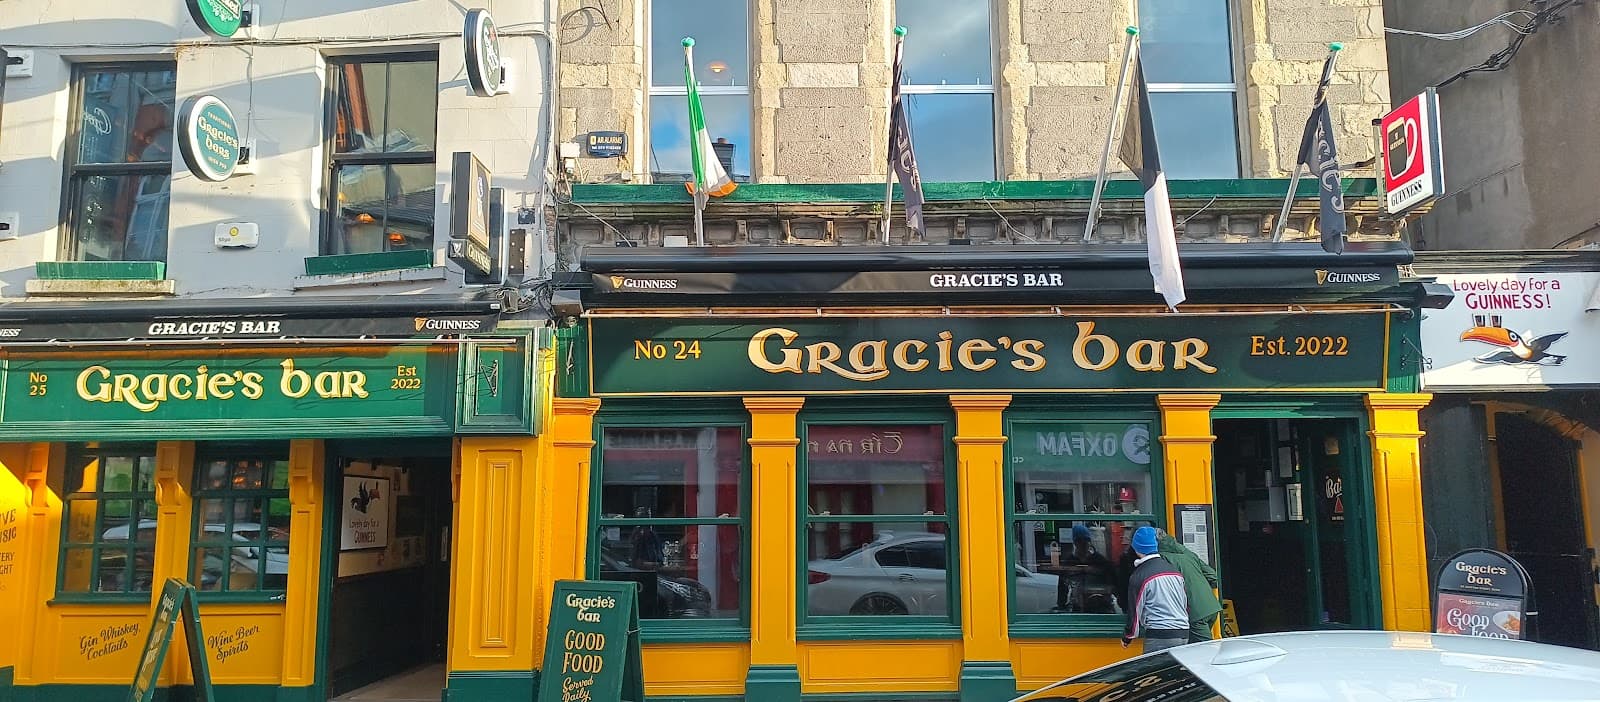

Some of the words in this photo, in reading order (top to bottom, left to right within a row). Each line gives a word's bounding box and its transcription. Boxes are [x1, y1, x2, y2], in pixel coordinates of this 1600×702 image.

[1391, 180, 1422, 206] GUINNESS
[624, 278, 678, 289] GUINNESS
[929, 273, 1018, 288] GRACIE'S
[1023, 273, 1064, 287] BAR
[1327, 272, 1380, 283] GUINNESS
[1453, 279, 1498, 294] Lovely
[1501, 278, 1526, 294] day
[1529, 277, 1548, 290] for
[1552, 280, 1560, 290] a
[148, 321, 237, 335] GRACIE'S
[239, 321, 281, 334] BAR
[426, 320, 480, 330] GUINNESS
[634, 340, 667, 360] No
[673, 340, 701, 360] 24
[748, 328, 1047, 382] Gracie's
[1072, 321, 1218, 374] bar
[1250, 335, 1291, 356] Est.
[1295, 336, 1349, 356] 2022
[30, 371, 48, 383] No
[396, 365, 417, 377] Est
[30, 385, 47, 396] 25
[76, 365, 264, 412] Gracie's
[279, 358, 369, 399] bar
[390, 378, 422, 390] 2022
[1456, 561, 1507, 575] Gracie's
[566, 593, 615, 610] Gracie's
[80, 635, 98, 655] Gin
[208, 631, 233, 648] Wine
[236, 626, 259, 640] Beer
[565, 629, 605, 651] GOOD
[87, 638, 128, 660] Cocktails
[216, 640, 248, 664] Spirits
[562, 652, 603, 674] FOOD
[562, 675, 594, 693] Served
